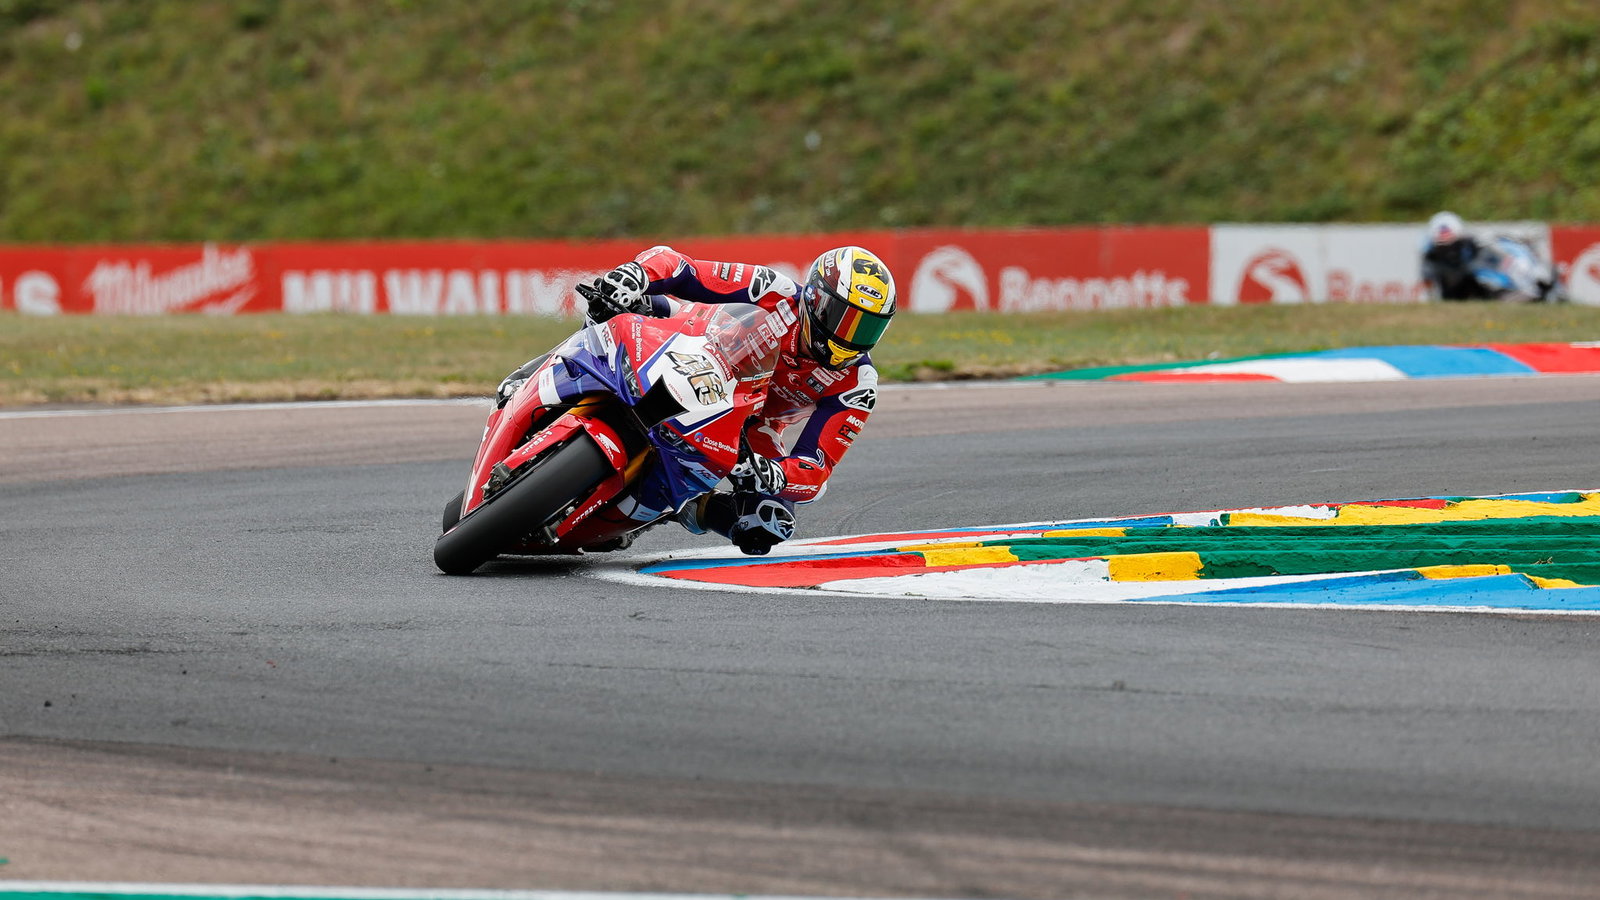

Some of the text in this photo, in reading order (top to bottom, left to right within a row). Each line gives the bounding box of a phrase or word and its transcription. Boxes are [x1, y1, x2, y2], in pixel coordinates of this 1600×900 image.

[859, 285, 881, 298] HJC
[715, 353, 731, 380] Bennetts
[703, 437, 738, 454] Close Brothers
